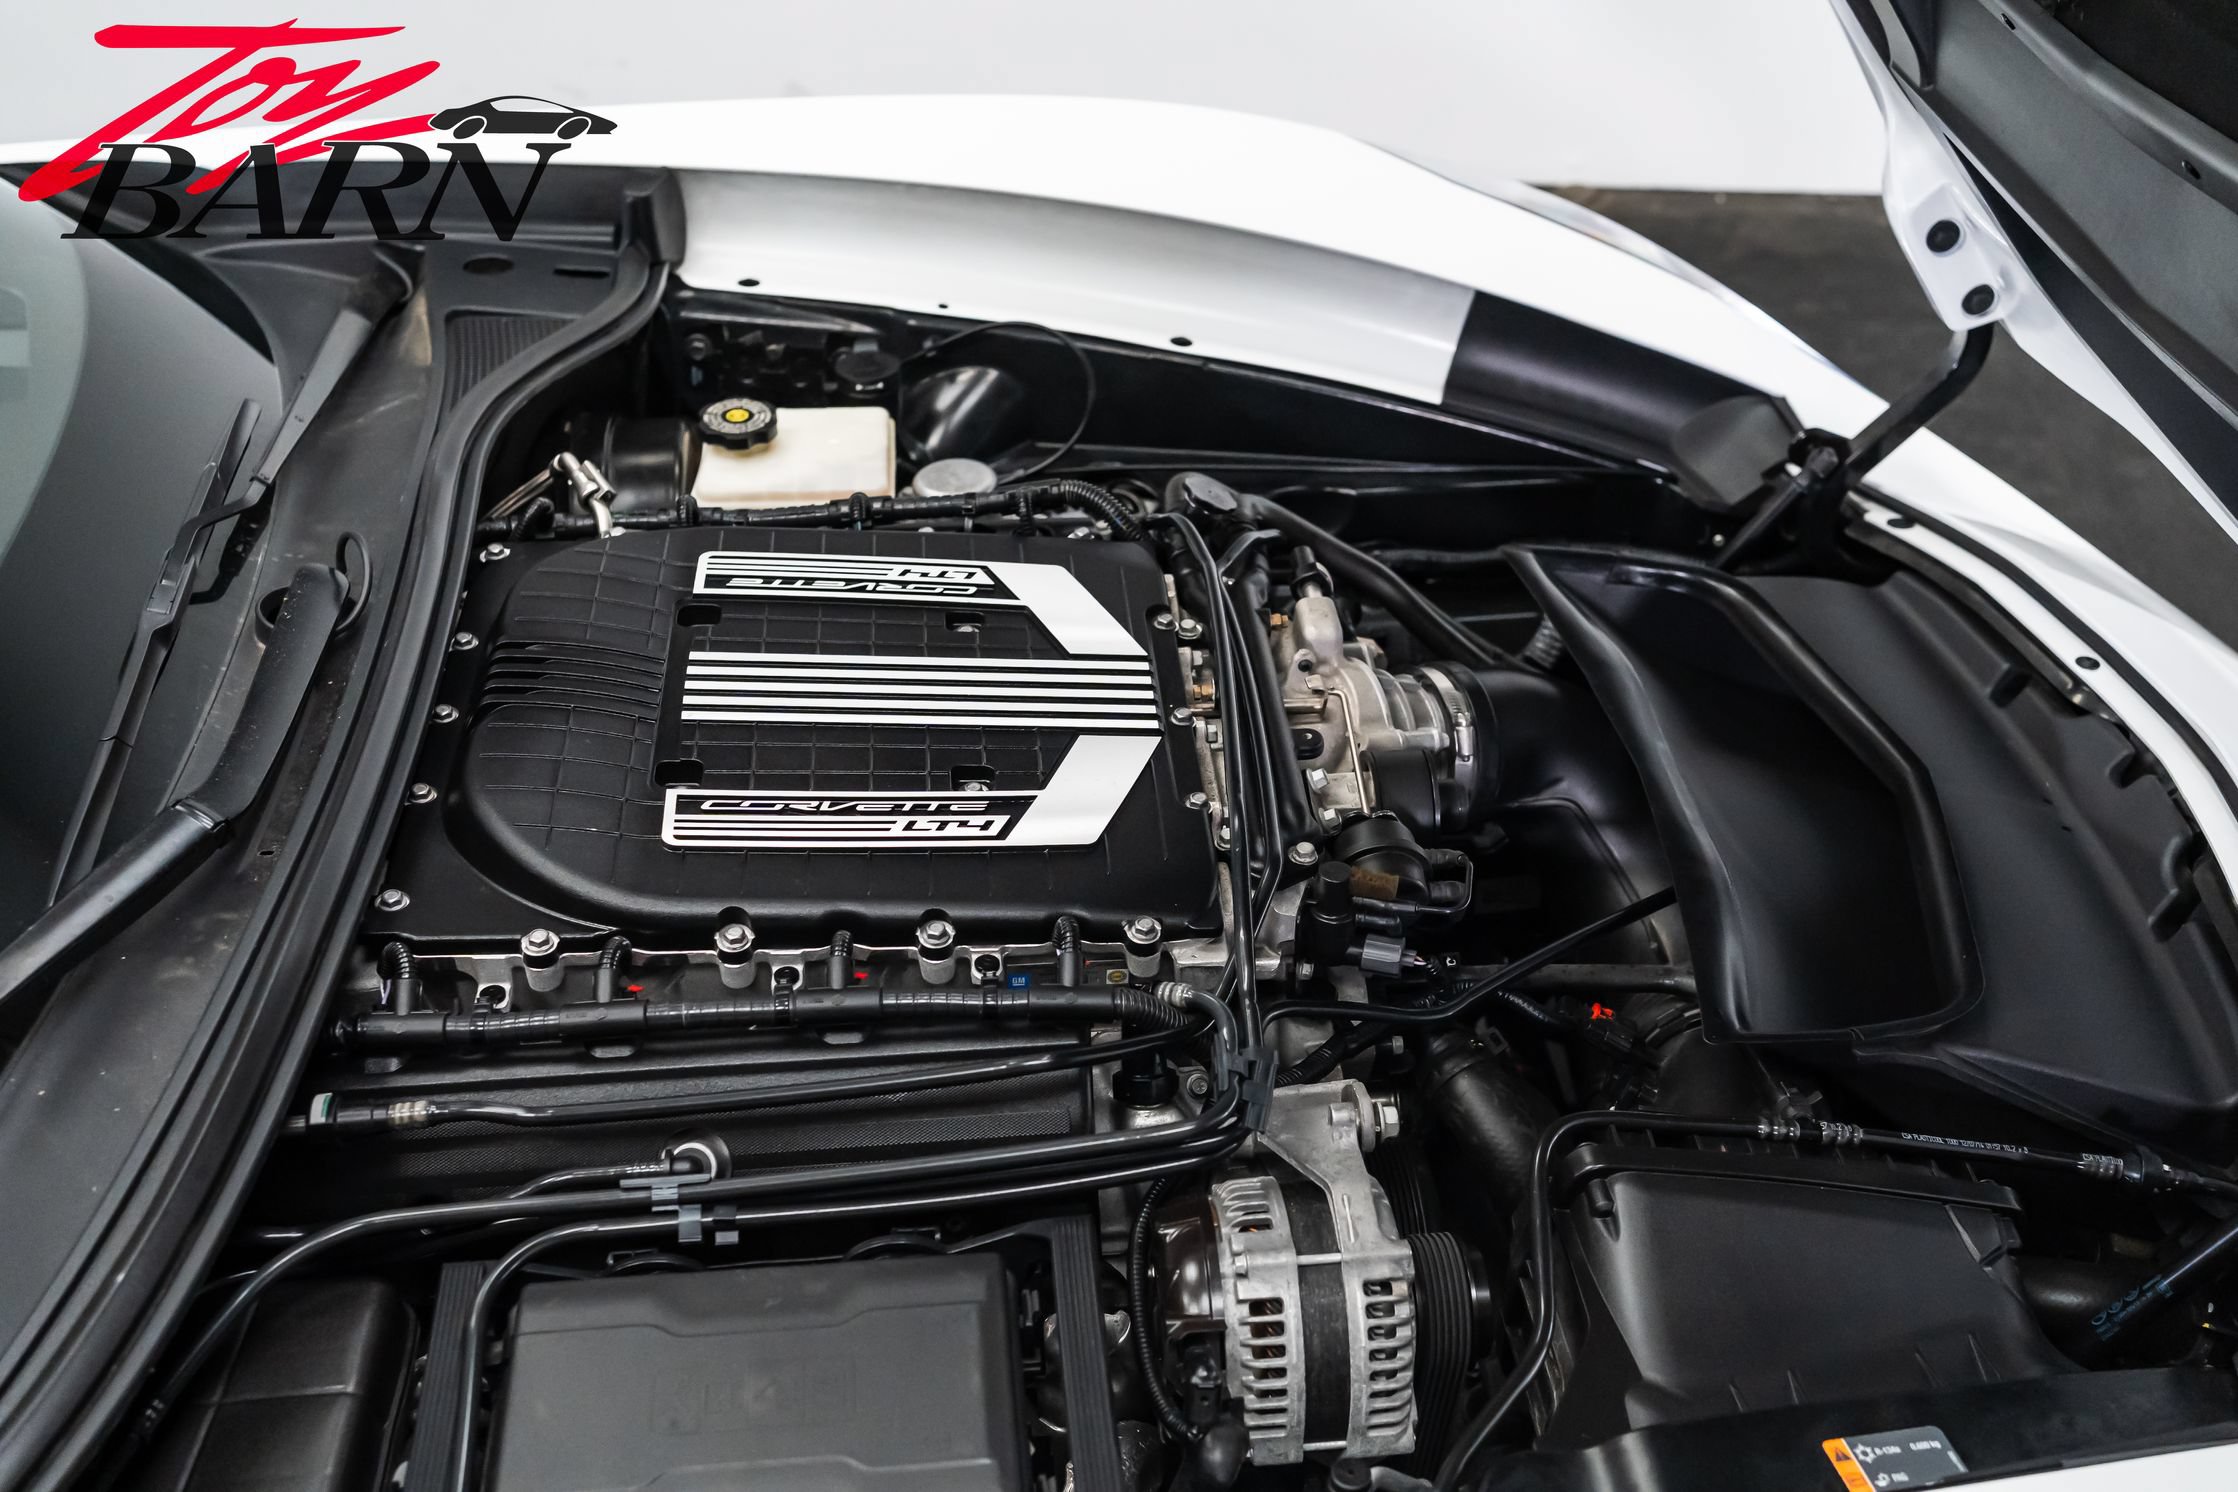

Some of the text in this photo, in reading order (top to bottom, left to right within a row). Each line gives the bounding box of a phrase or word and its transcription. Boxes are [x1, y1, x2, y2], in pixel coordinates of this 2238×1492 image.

[897, 567, 979, 581] LT4
[725, 577, 979, 596] CORVETTE
[700, 800, 989, 812] CORVETTE
[901, 819, 997, 832] LT4
